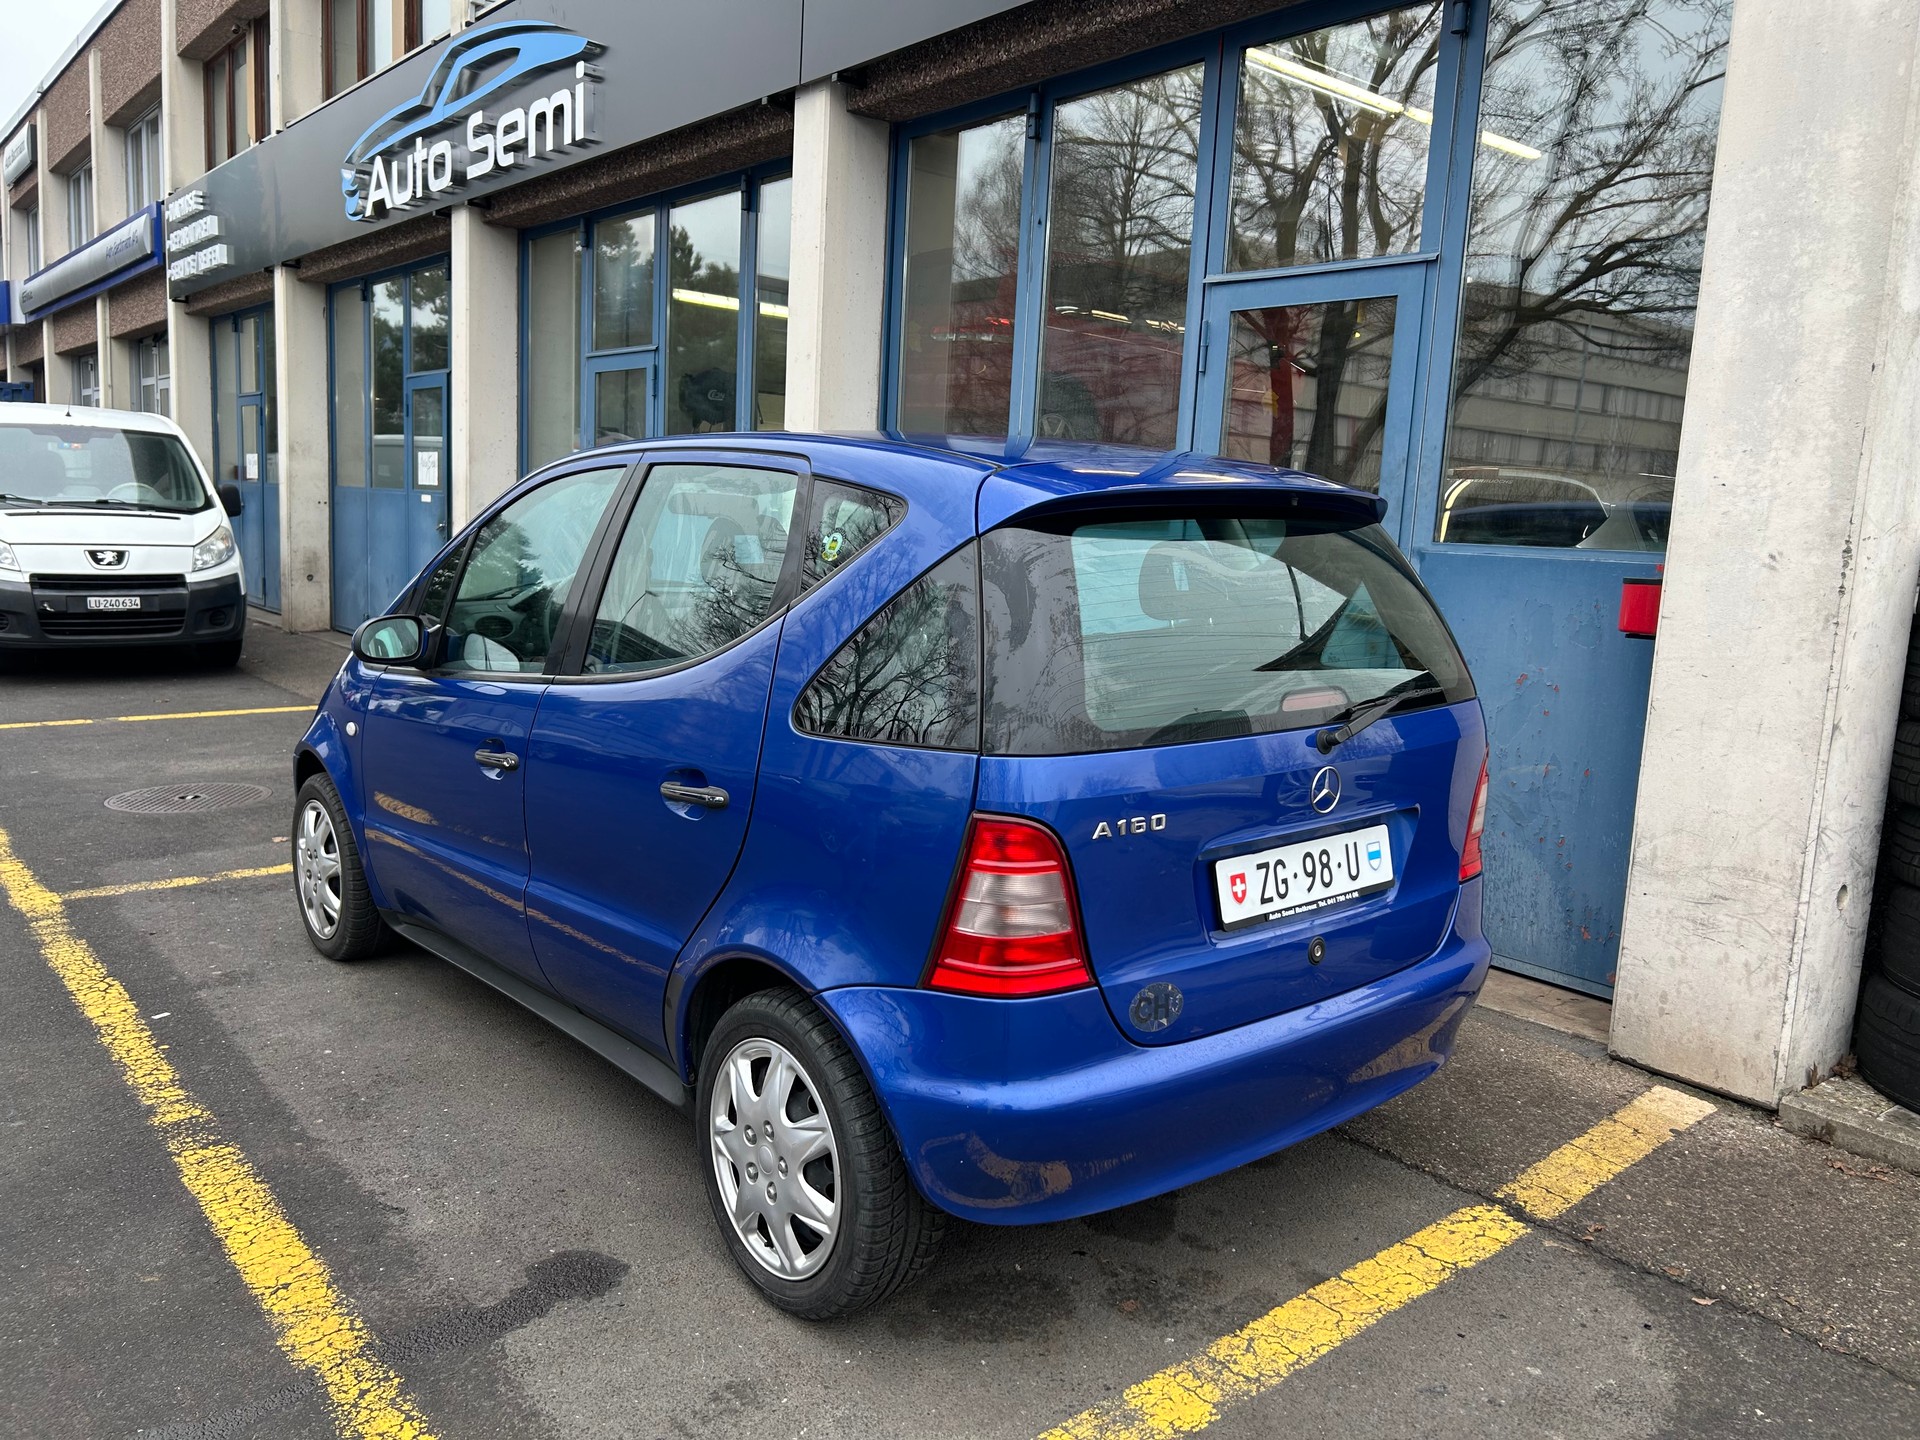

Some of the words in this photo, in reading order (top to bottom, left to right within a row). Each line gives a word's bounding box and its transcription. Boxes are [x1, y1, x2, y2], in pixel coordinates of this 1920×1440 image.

[365, 136, 453, 218] Auto
[467, 60, 585, 181] Semi
[1269, 912, 1281, 920] Auto
